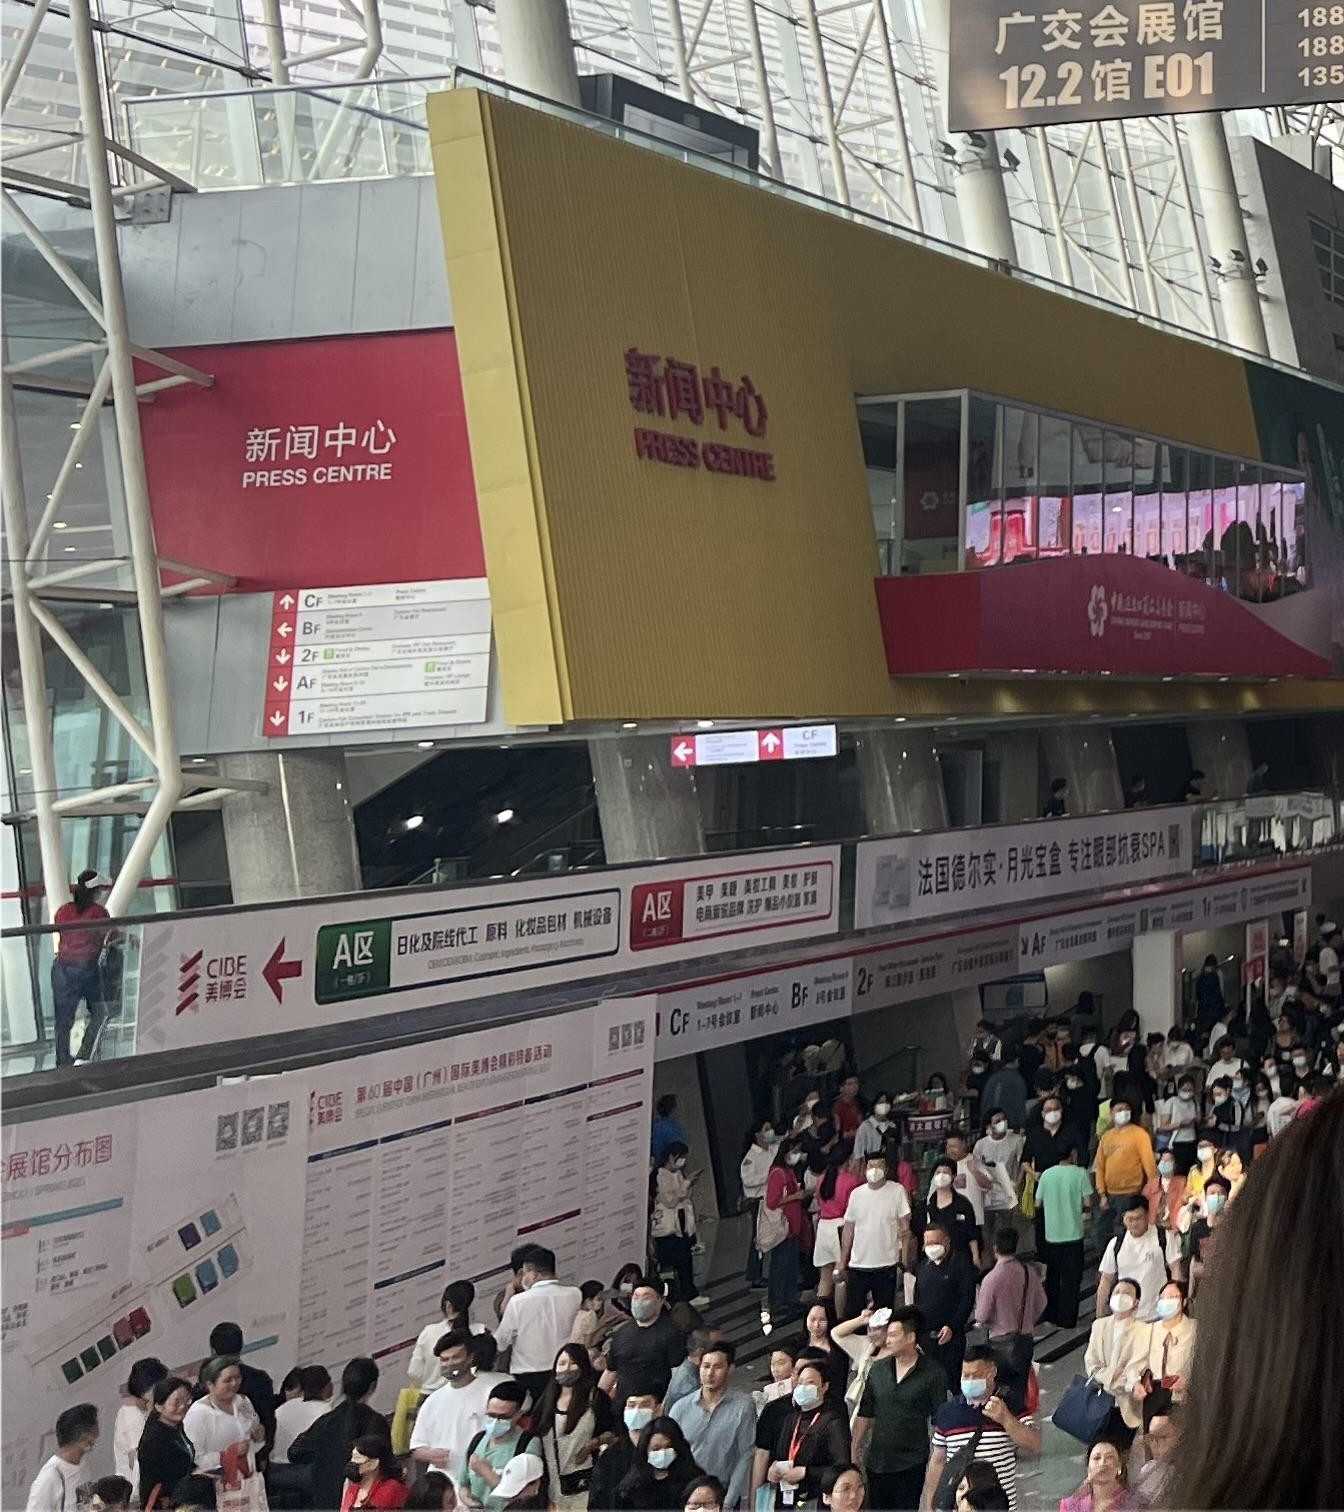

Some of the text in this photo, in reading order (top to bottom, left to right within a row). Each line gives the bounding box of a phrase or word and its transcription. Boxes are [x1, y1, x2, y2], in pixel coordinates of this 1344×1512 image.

[995, 0, 1224, 56] 广交会展馆
[999, 51, 1214, 111] 12.2馆 E01
[624, 346, 769, 438] 新闻中心
[245, 419, 396, 463] 新闻中心
[633, 427, 776, 482] PRESS CENTRE
[242, 463, 392, 488] PRESS CENTRE
[304, 594, 323, 608] CF
[302, 621, 321, 636] BF
[301, 648, 319, 662] 2F
[296, 676, 317, 690] AF
[298, 710, 315, 724] 1F
[643, 890, 673, 923] A区
[333, 931, 374, 969] A区
[791, 982, 808, 1009] BF
[670, 1008, 689, 1036] CF
